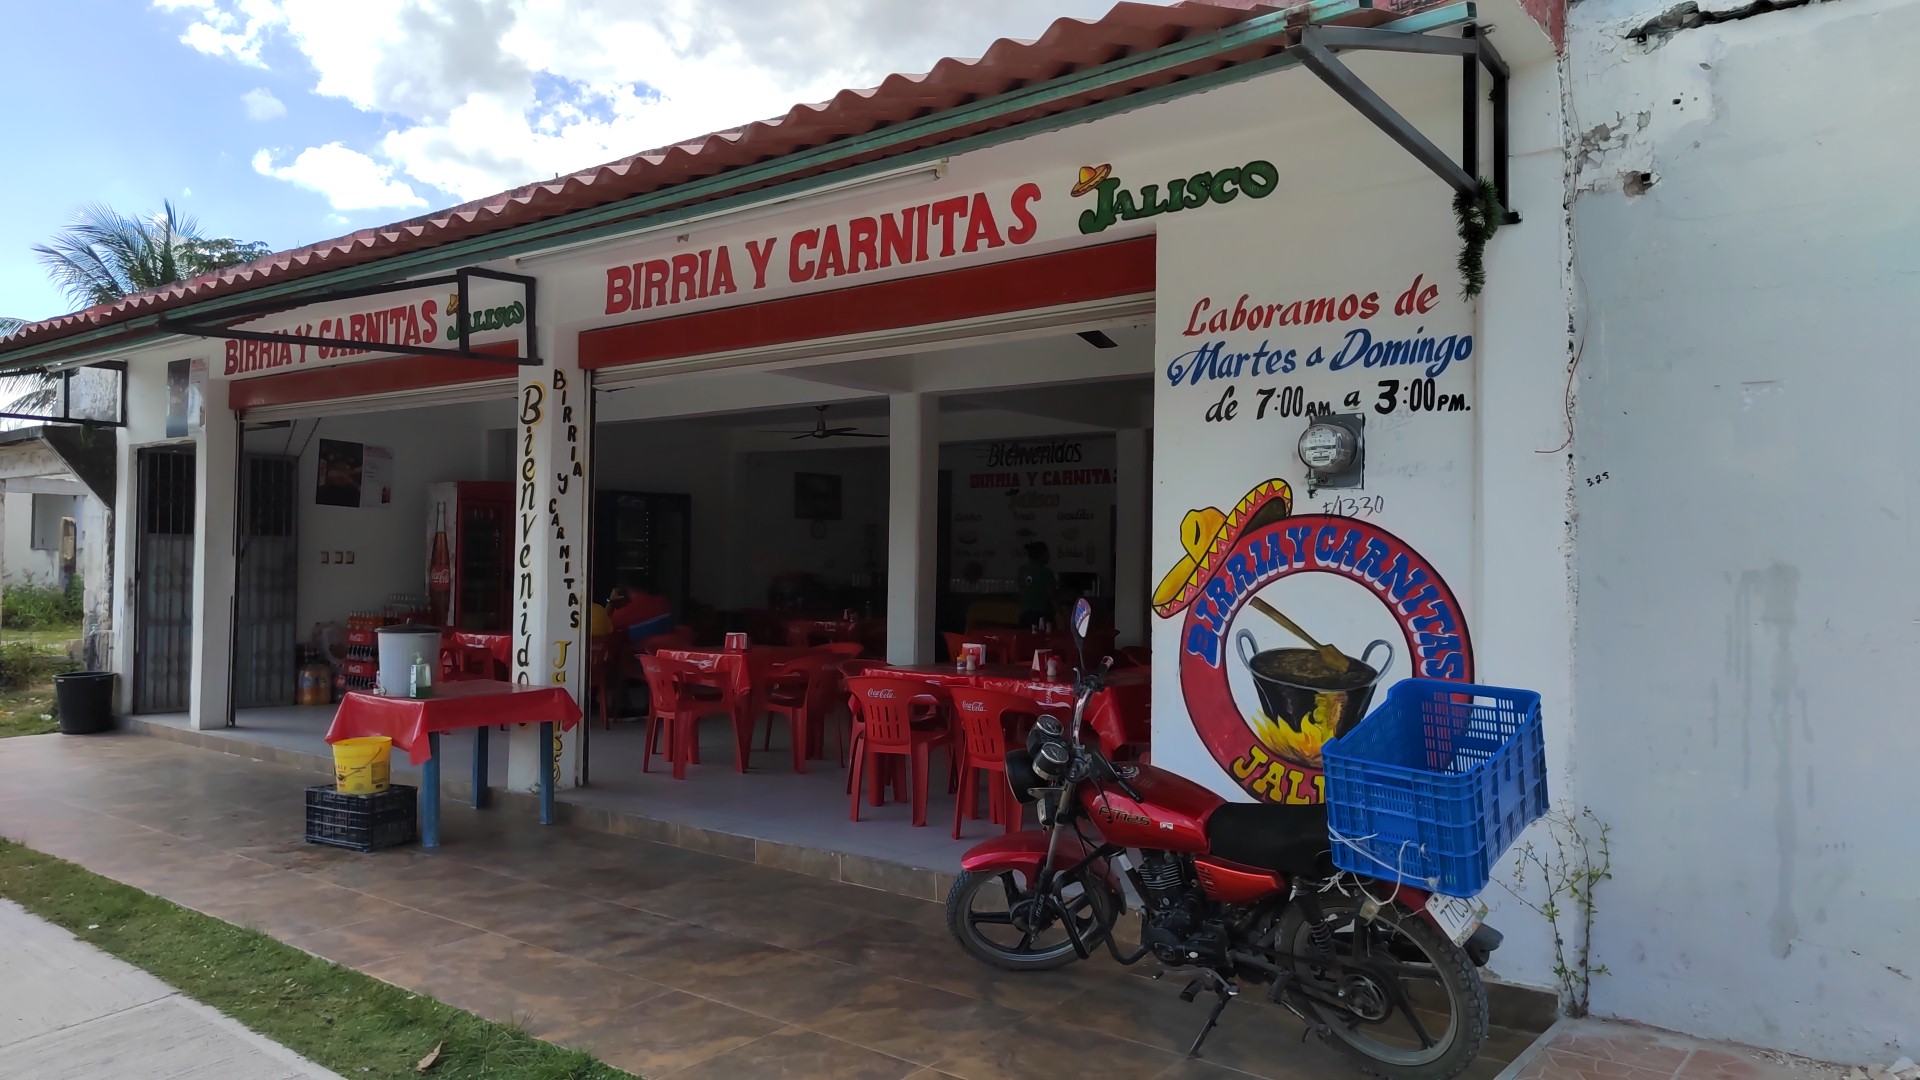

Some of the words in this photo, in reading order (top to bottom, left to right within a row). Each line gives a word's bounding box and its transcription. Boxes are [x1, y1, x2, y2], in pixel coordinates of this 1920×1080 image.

[1078, 159, 1280, 236] JALISCO
[604, 247, 737, 315] BIRRIA
[745, 236, 777, 290] Y
[788, 183, 1042, 284] CARNITAS
[223, 328, 293, 376] BIRRIA
[295, 323, 313, 363] Y
[318, 299, 438, 358] CARNITAS
[446, 300, 526, 341] JLISCO
[1181, 289, 1380, 336] Laboramos
[1393, 273, 1440, 316] de
[1166, 341, 1298, 387] Martes
[1306, 347, 1325, 366] a
[1329, 326, 1474, 379] Domingo
[552, 368, 583, 478] BIRRIA
[1205, 386, 1240, 423] de
[1344, 389, 1362, 410] a
[969, 472, 1021, 489] BIRRIA
[1026, 471, 1038, 487] Y
[986, 440, 1082, 468] Bienvenidos
[515, 383, 546, 729] Bienvenido
[548, 497, 580, 630] CARNITAS
[1187, 534, 1295, 670] BIRRIA
[1286, 526, 1313, 568] Y
[1313, 525, 1466, 680] CARNITAS
[551, 640, 573, 784] Jasco
[1229, 745, 1326, 805] JALI
